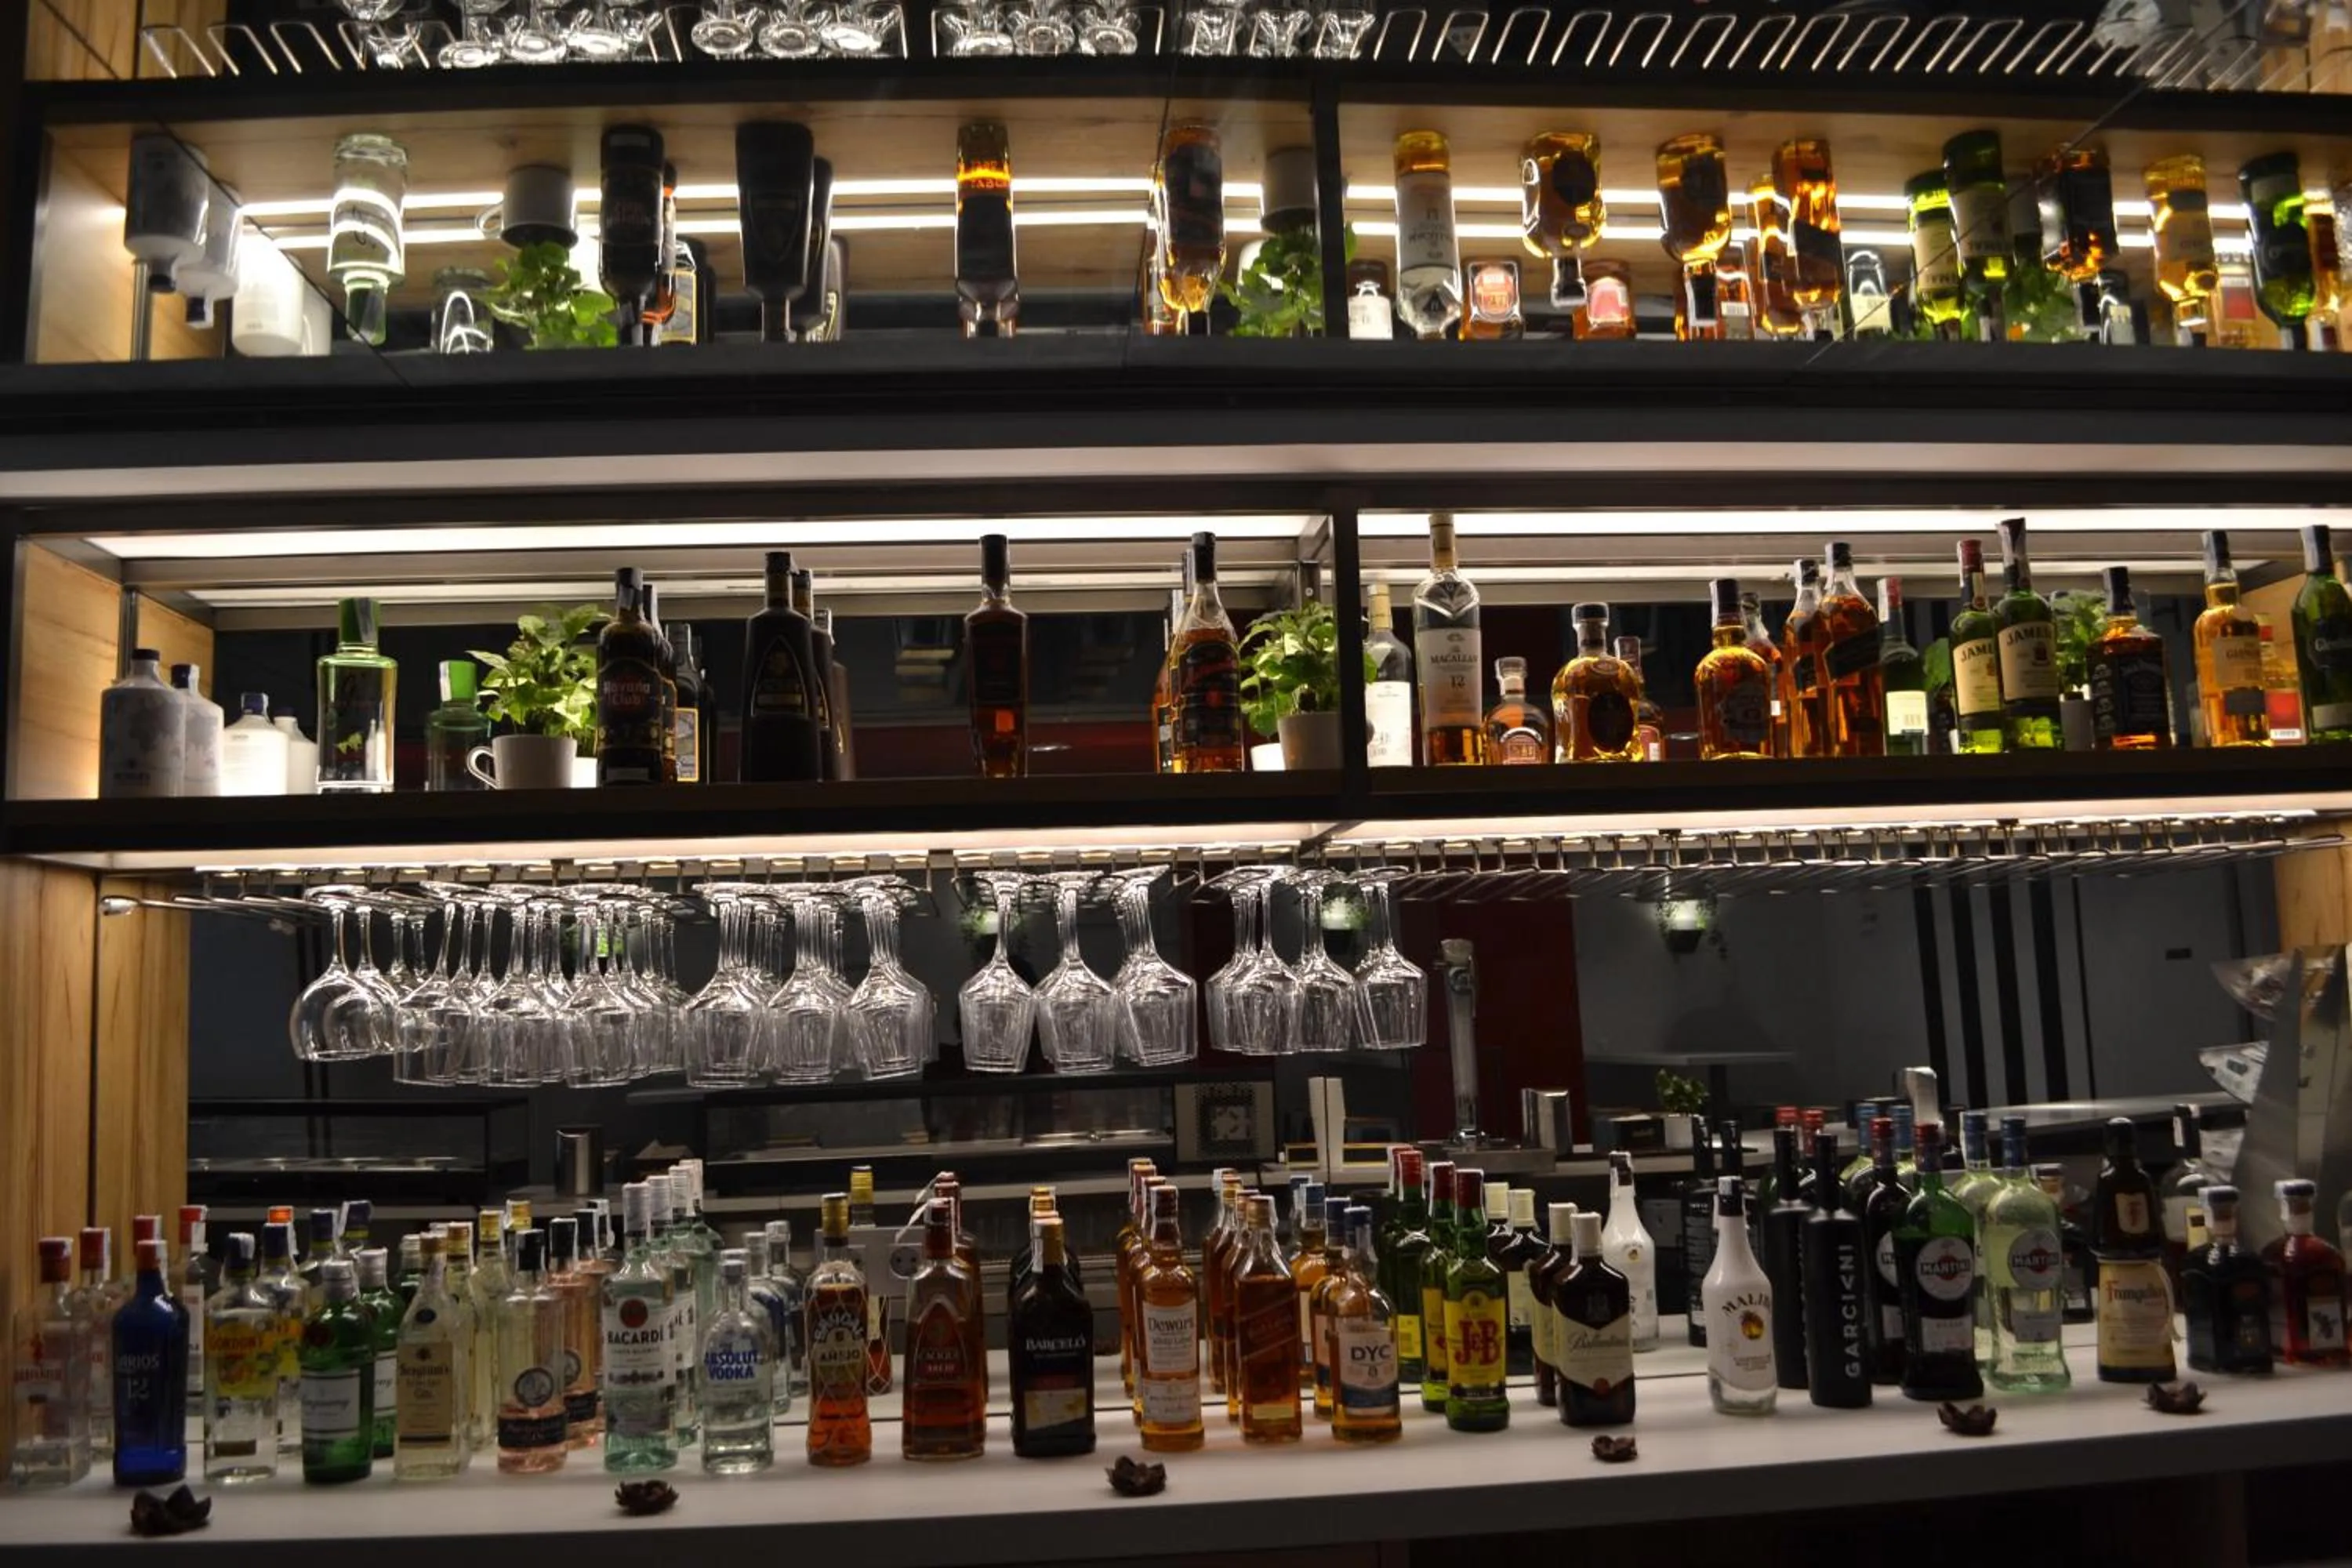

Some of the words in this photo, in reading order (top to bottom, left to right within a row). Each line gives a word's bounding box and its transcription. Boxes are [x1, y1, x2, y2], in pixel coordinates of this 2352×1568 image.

[1450, 675, 1465, 689] 12
[1025, 1333, 1087, 1352] BARCELÓ
[1454, 1319, 1501, 1367] J&B
[118, 1353, 161, 1370] ARIOS
[704, 1348, 758, 1367] ABSOLUT
[1350, 1344, 1392, 1362] DYC
[708, 1363, 756, 1381] VODKA
